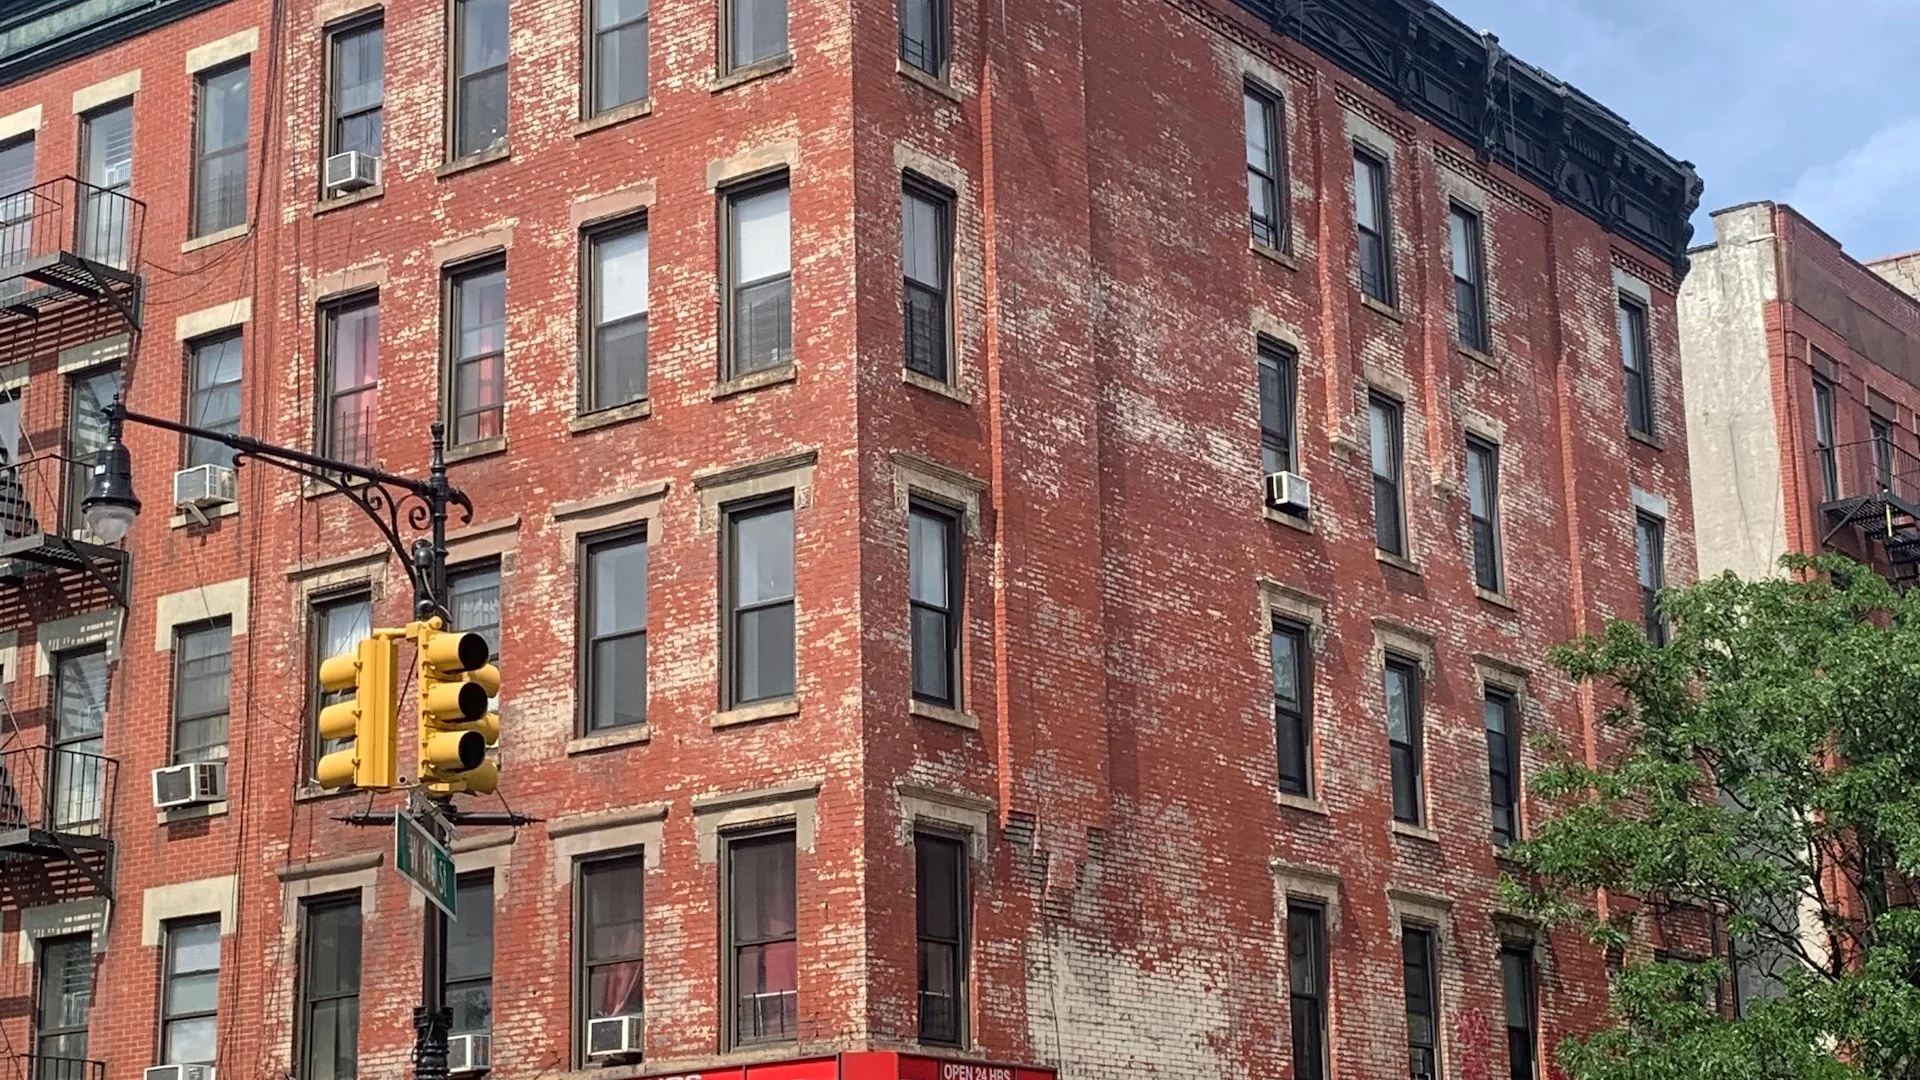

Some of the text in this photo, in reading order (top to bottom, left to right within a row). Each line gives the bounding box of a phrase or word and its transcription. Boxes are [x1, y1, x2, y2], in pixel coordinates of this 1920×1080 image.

[408, 832, 419, 872] W
[944, 1064, 1011, 1080] OPEN 24 HRS
